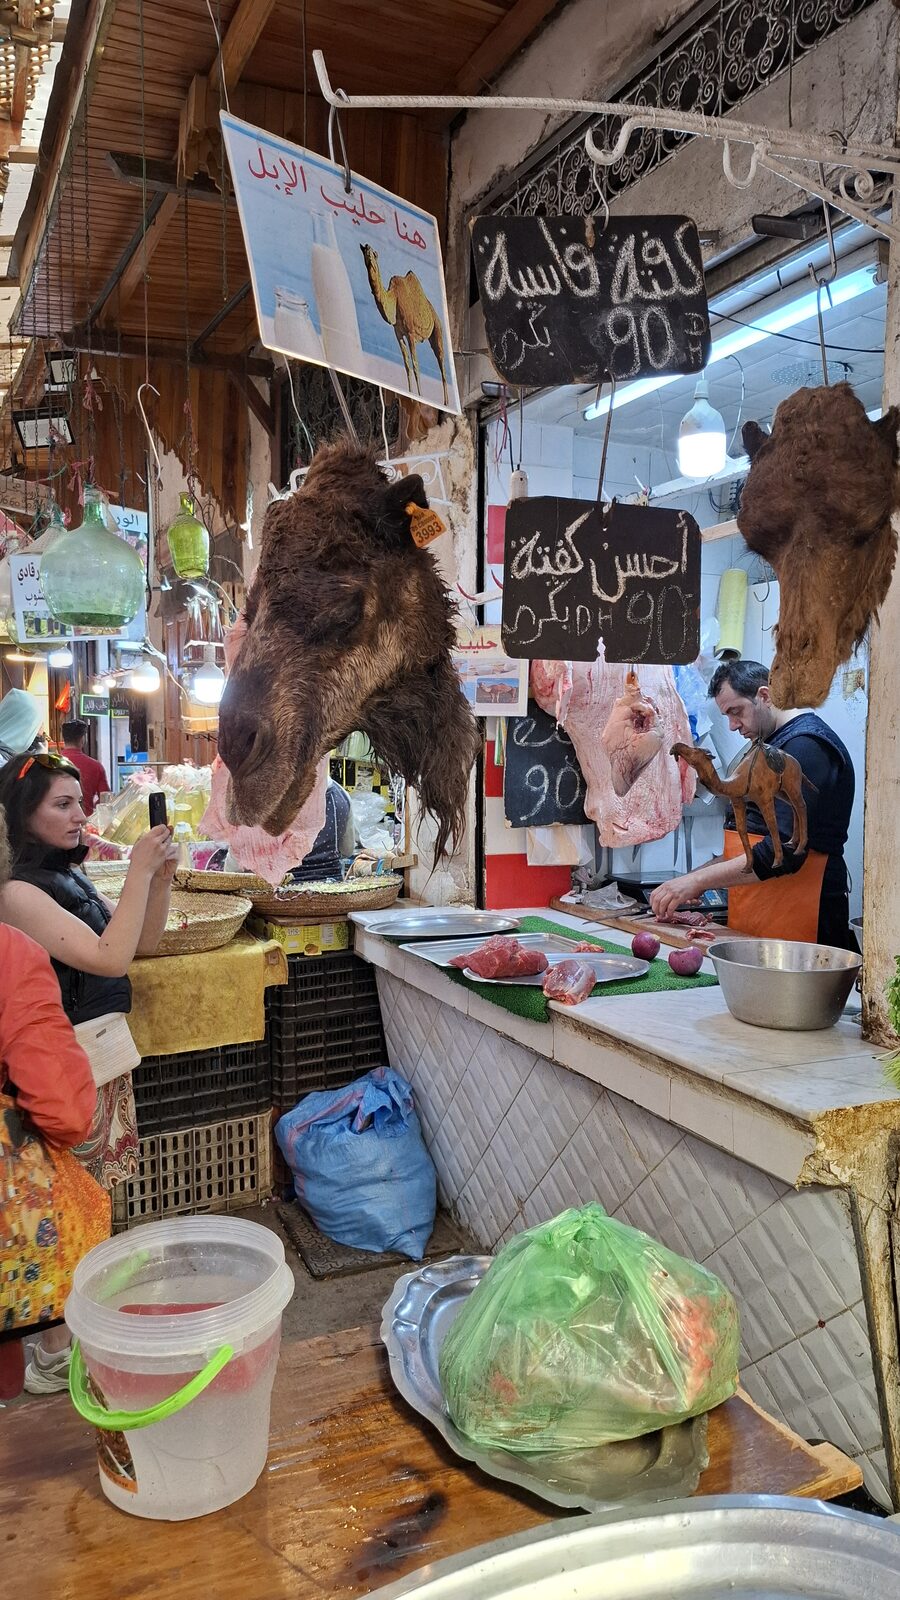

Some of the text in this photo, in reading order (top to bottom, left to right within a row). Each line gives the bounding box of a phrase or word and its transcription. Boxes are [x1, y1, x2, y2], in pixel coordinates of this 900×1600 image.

[248, 147, 427, 250] هنا حليب الإبل
[605, 305, 675, 380] 90
[415, 521, 443, 544] 3993
[510, 507, 690, 604] أحسن كفتة
[458, 632, 498, 654] حليب
[576, 604, 613, 636] DH
[616, 585, 694, 664] 90
[519, 763, 581, 821] 90
